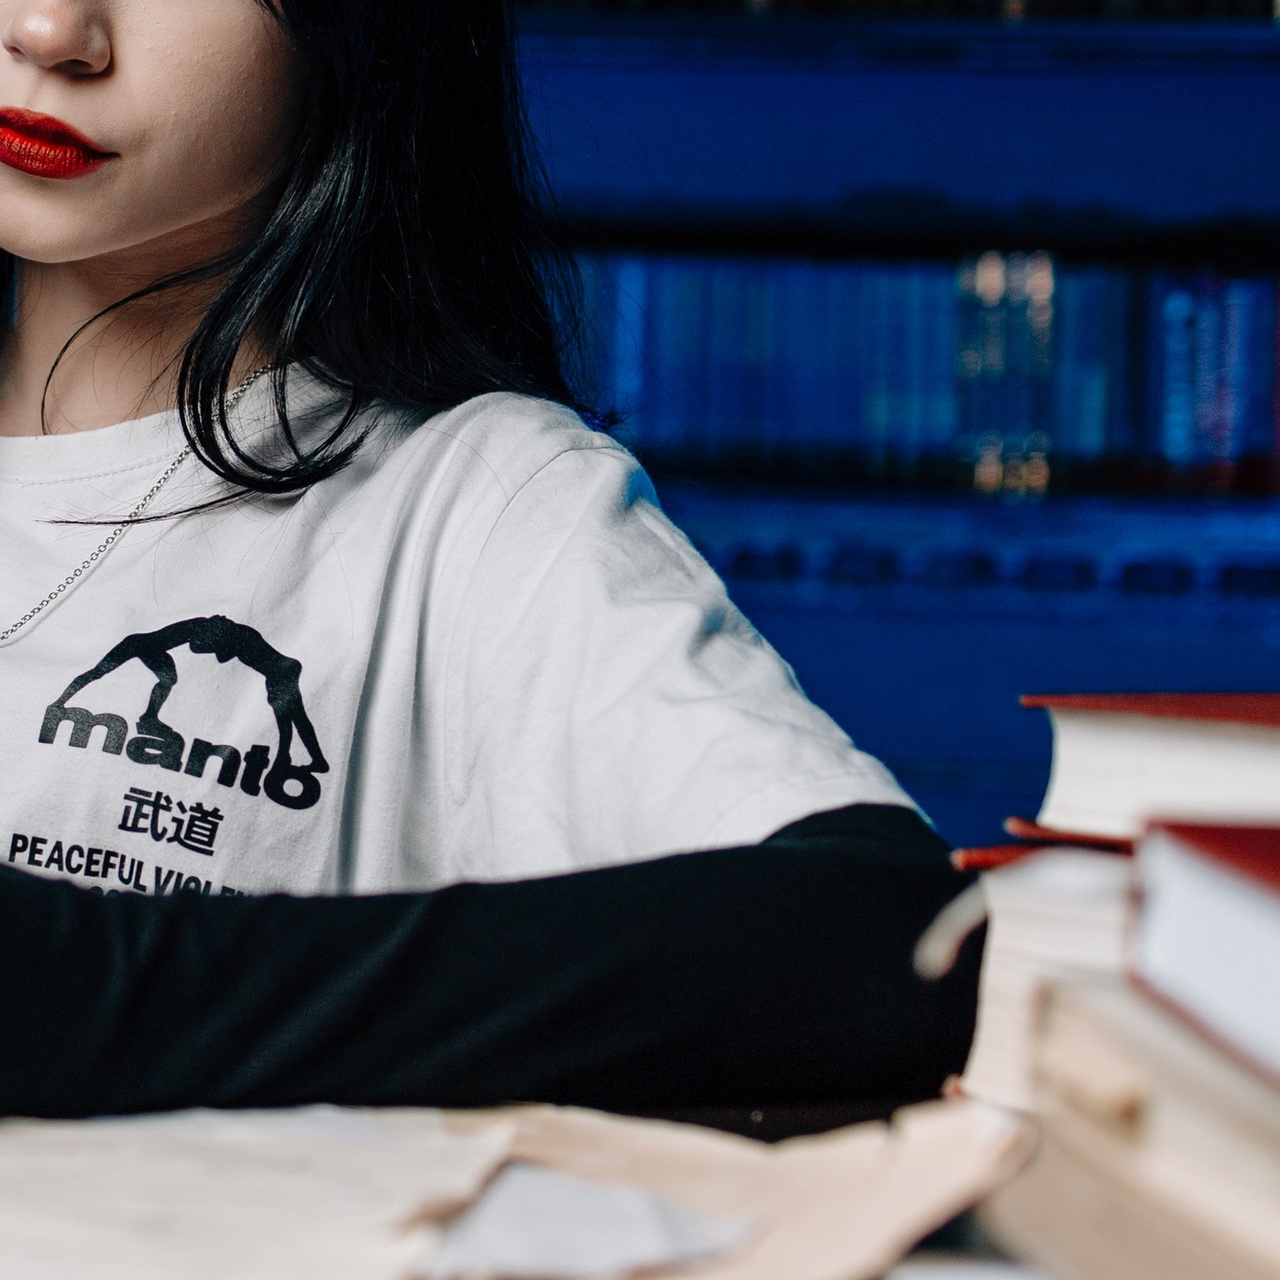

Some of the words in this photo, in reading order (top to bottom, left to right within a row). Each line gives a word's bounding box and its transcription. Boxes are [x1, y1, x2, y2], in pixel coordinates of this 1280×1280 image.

[38, 704, 322, 810] manto
[118, 787, 224, 857] 武道
[8, 833, 147, 893] PEACEFUL
